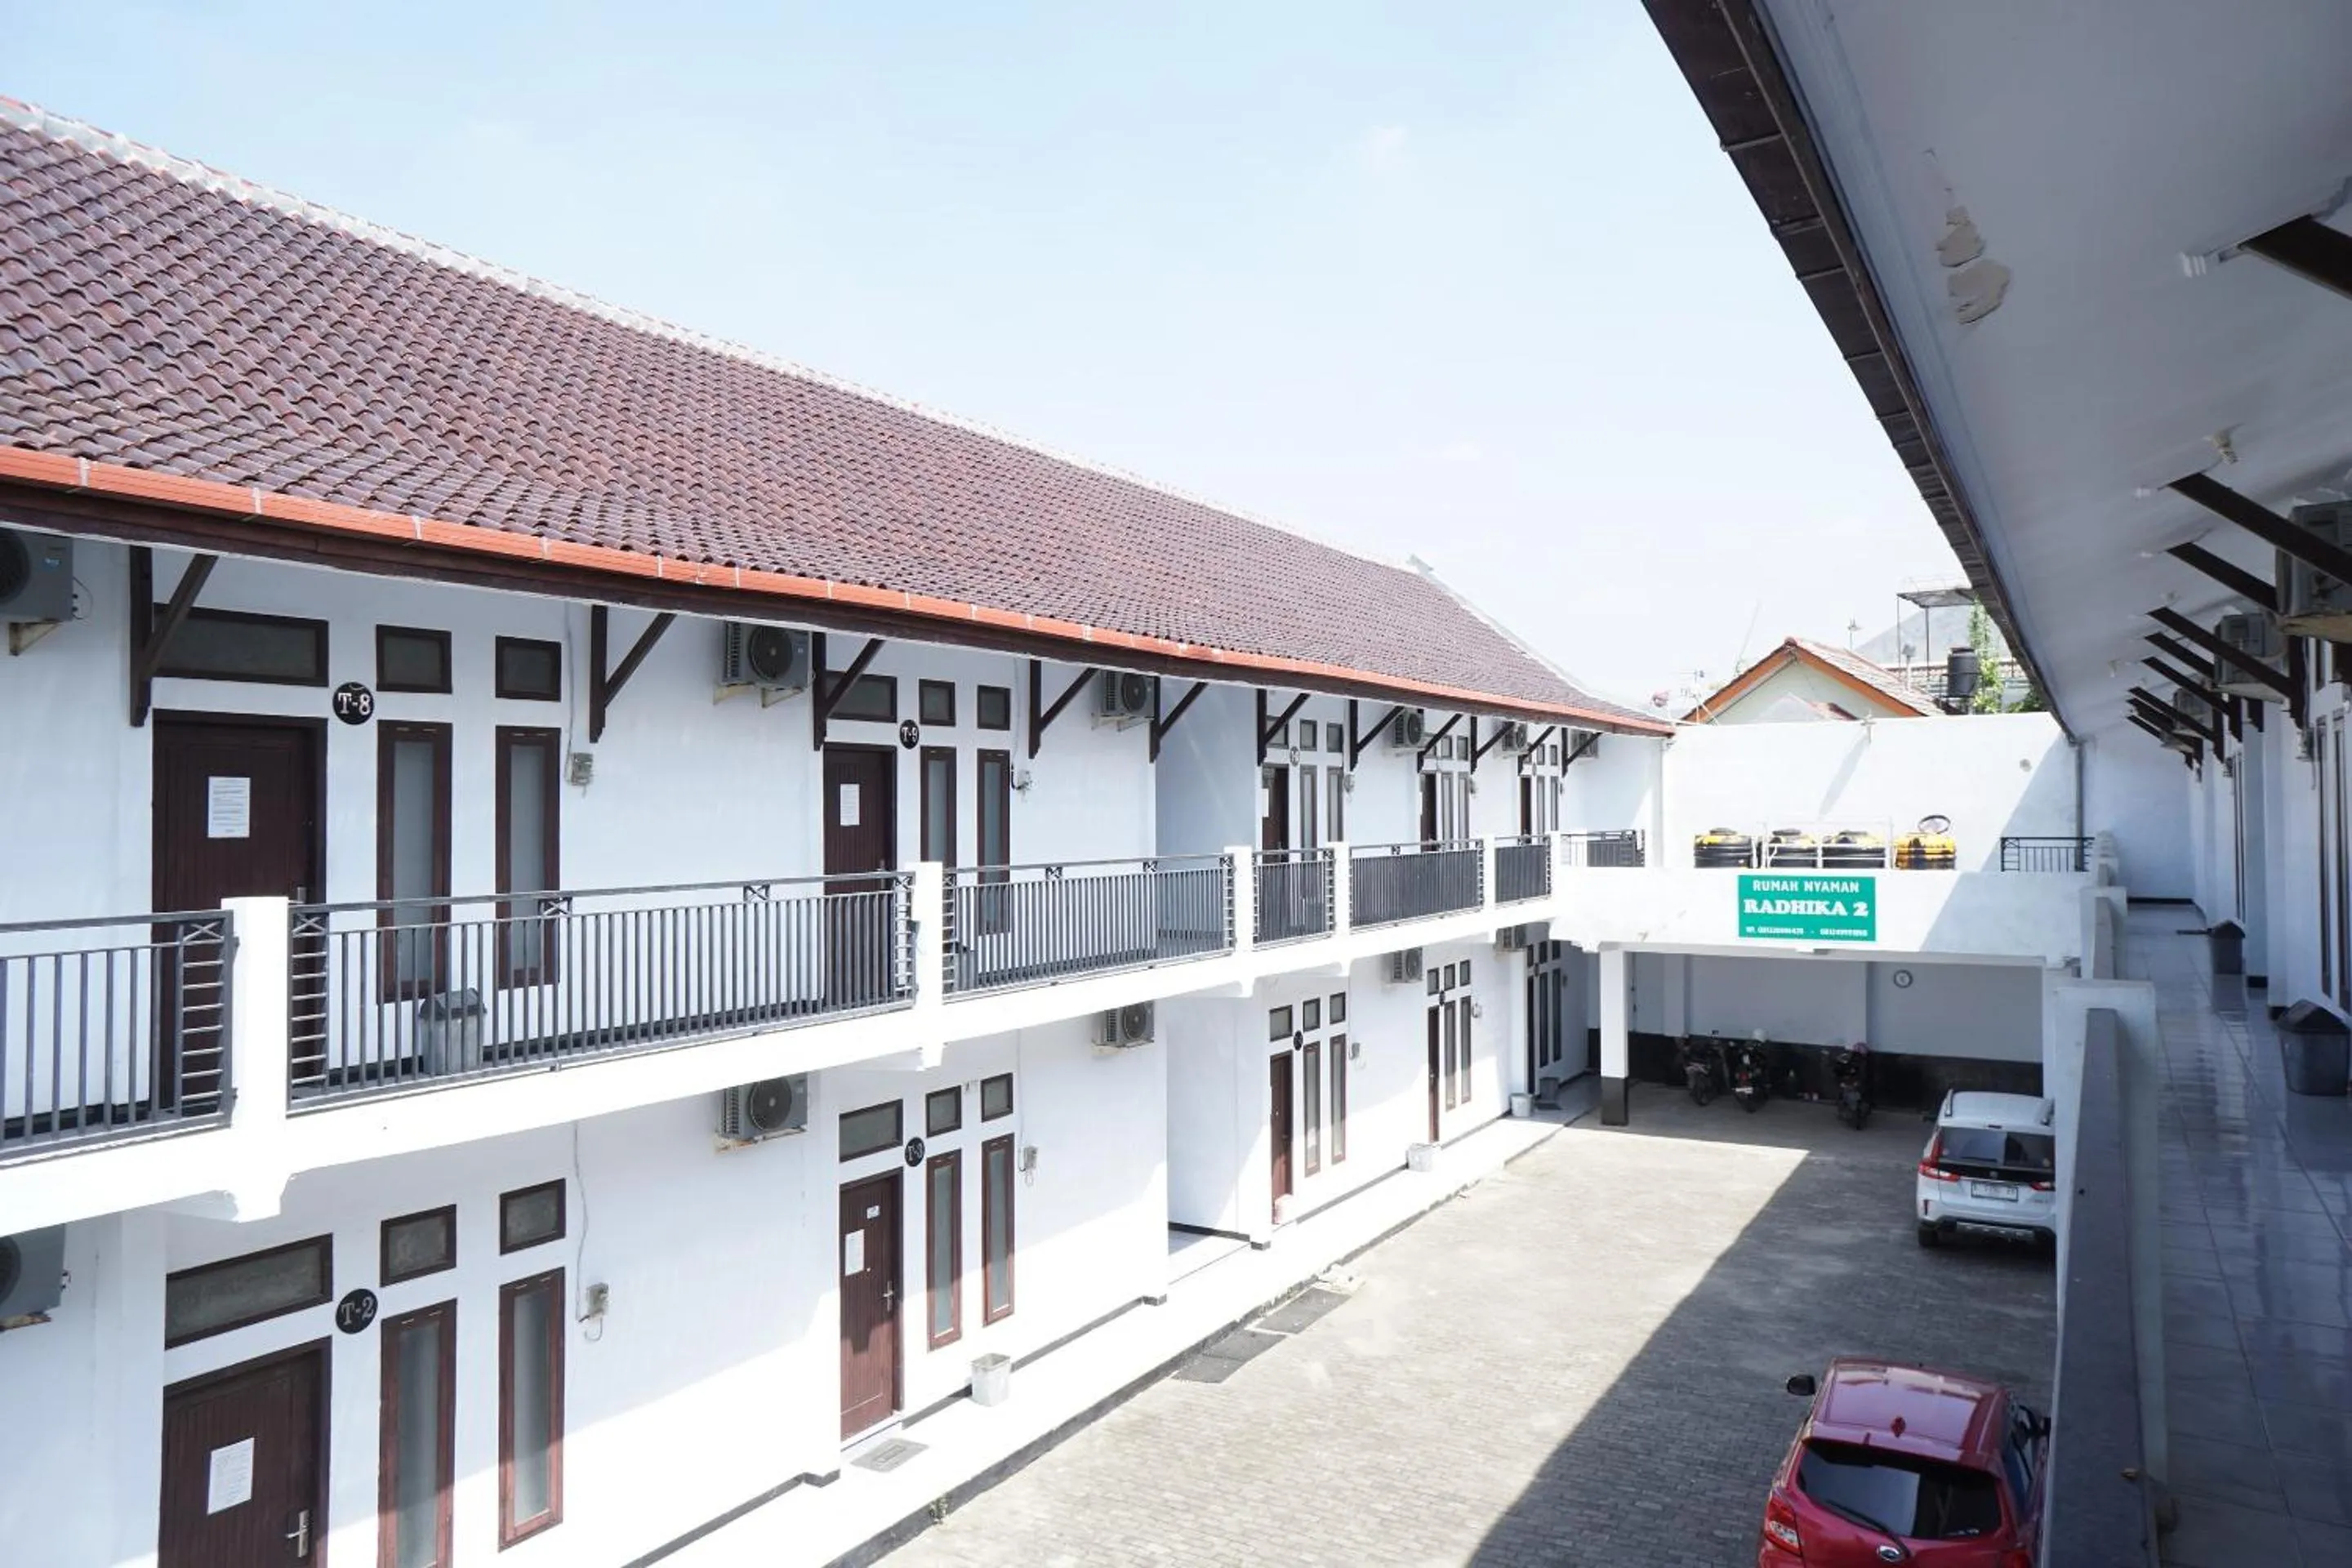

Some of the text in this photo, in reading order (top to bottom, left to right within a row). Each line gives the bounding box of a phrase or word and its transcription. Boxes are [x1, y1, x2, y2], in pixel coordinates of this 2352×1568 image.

[337, 692, 372, 715] T-8
[1753, 880, 1860, 893] RUMAH NYAMAN
[1743, 898, 1869, 917] RADHIKA 2
[341, 1296, 376, 1326] T-2
